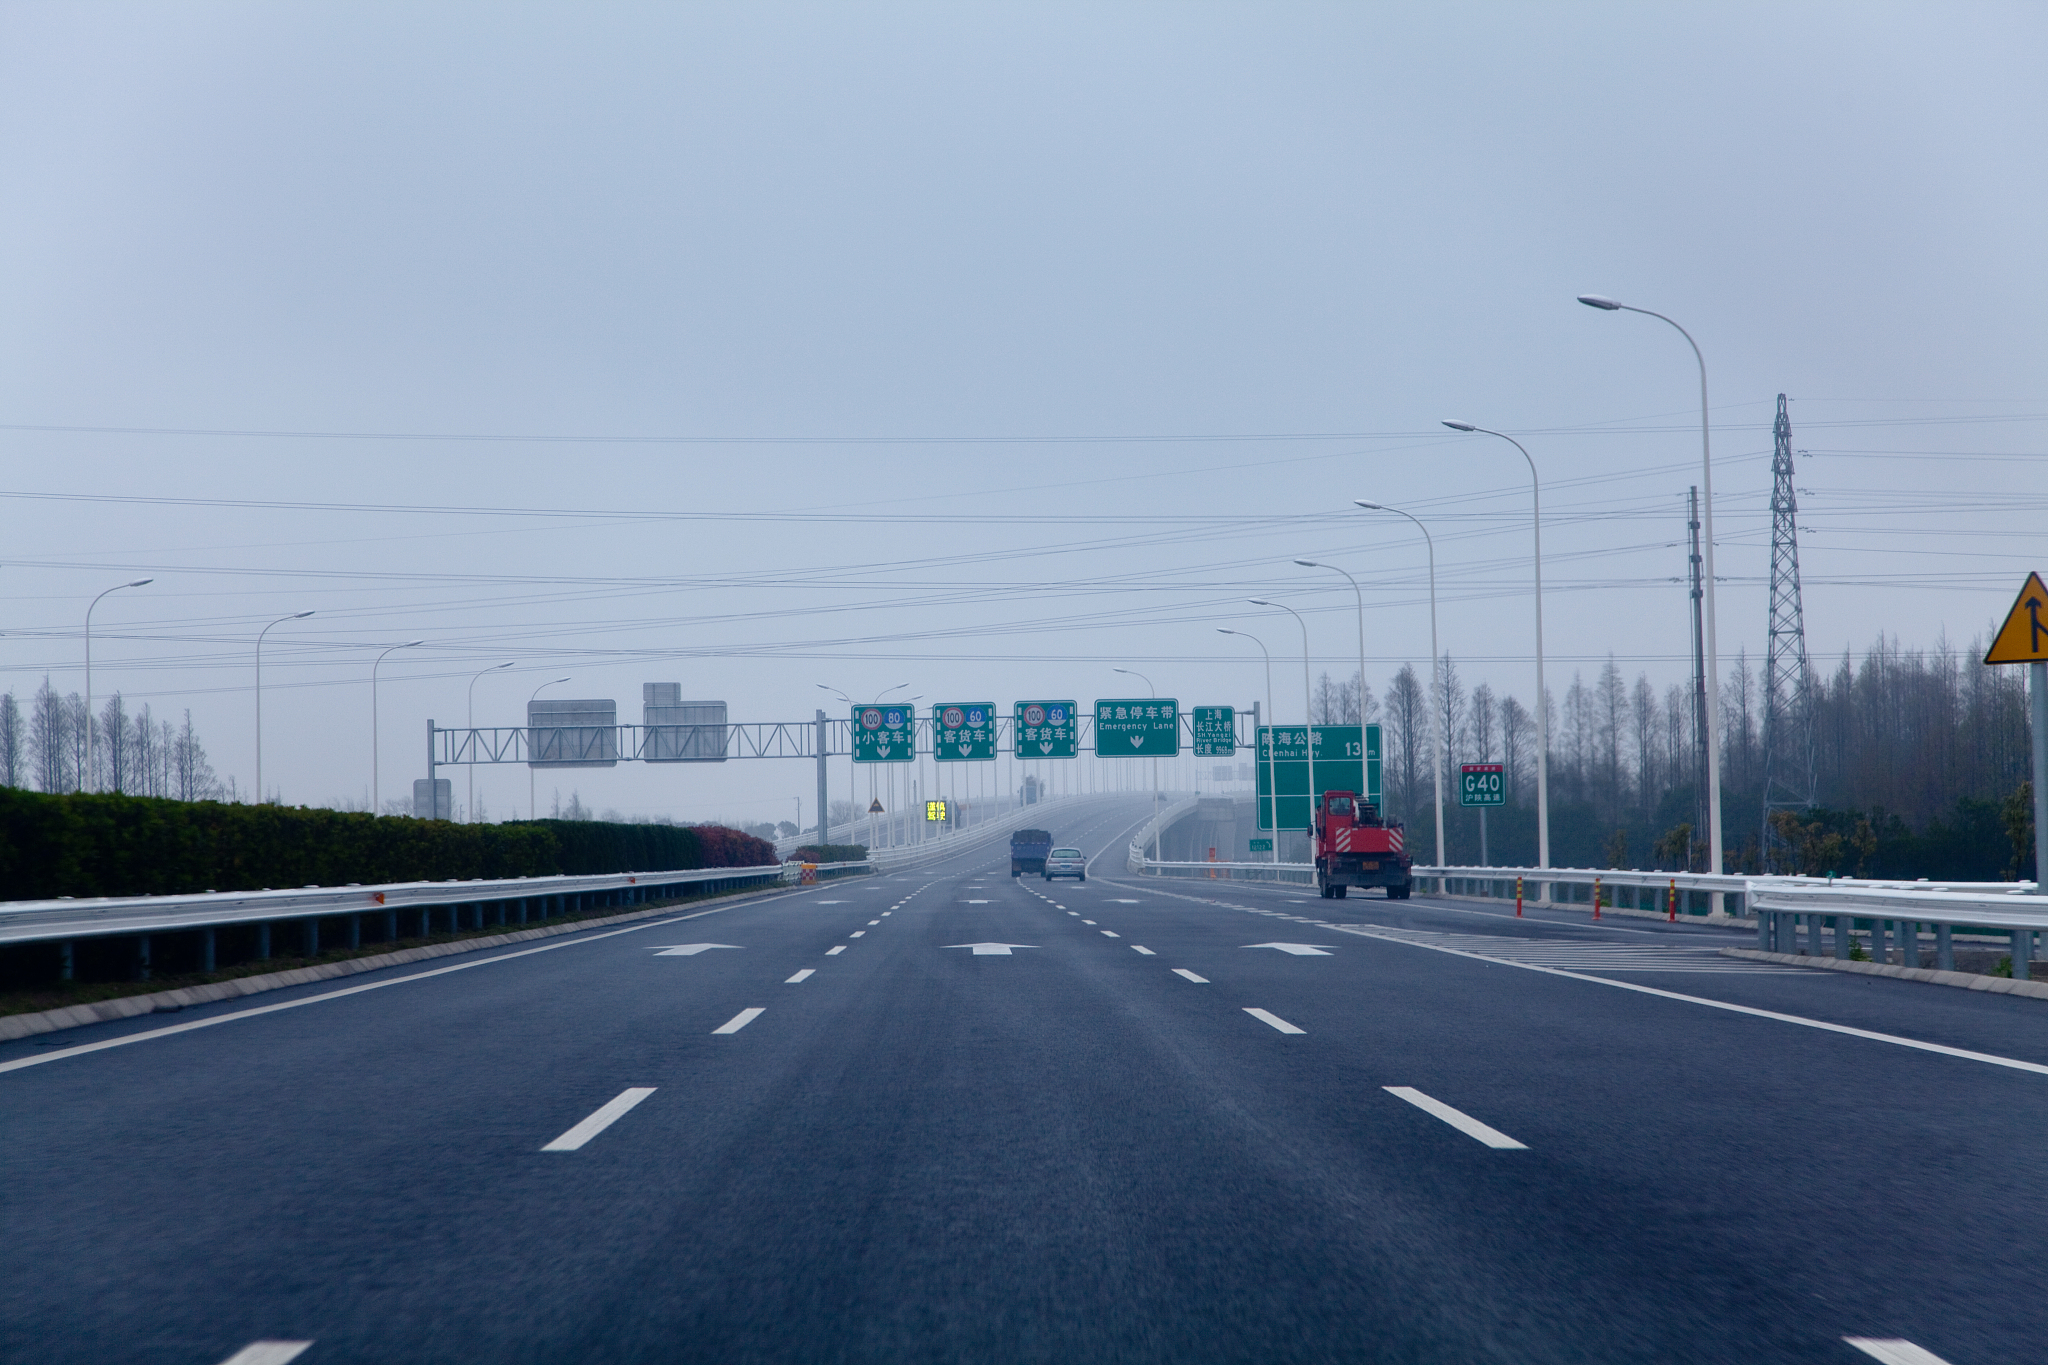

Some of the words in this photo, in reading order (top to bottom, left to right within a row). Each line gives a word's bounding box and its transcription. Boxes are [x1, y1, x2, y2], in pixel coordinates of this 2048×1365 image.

[888, 712, 901, 724] 80
[946, 713, 960, 724] 100
[969, 711, 982, 722] 60
[1027, 710, 1041, 721] 100
[1050, 709, 1063, 720] 60
[1099, 706, 1174, 720] 紧急停车带
[1205, 709, 1222, 720] 上海
[865, 714, 879, 725] 100
[1099, 723, 1148, 732] Emergency
[1153, 722, 1174, 730] Lane
[1196, 721, 1232, 732] 长江大桥
[862, 731, 905, 745] 小客车
[943, 729, 986, 744] 客货车
[1024, 727, 1068, 741] 客货车
[1195, 743, 1213, 754] 长度
[1262, 749, 1298, 757] Cenhai
[1301, 749, 1323, 758] Hy.
[1345, 742, 1361, 756] 13
[1465, 774, 1500, 792] G40
